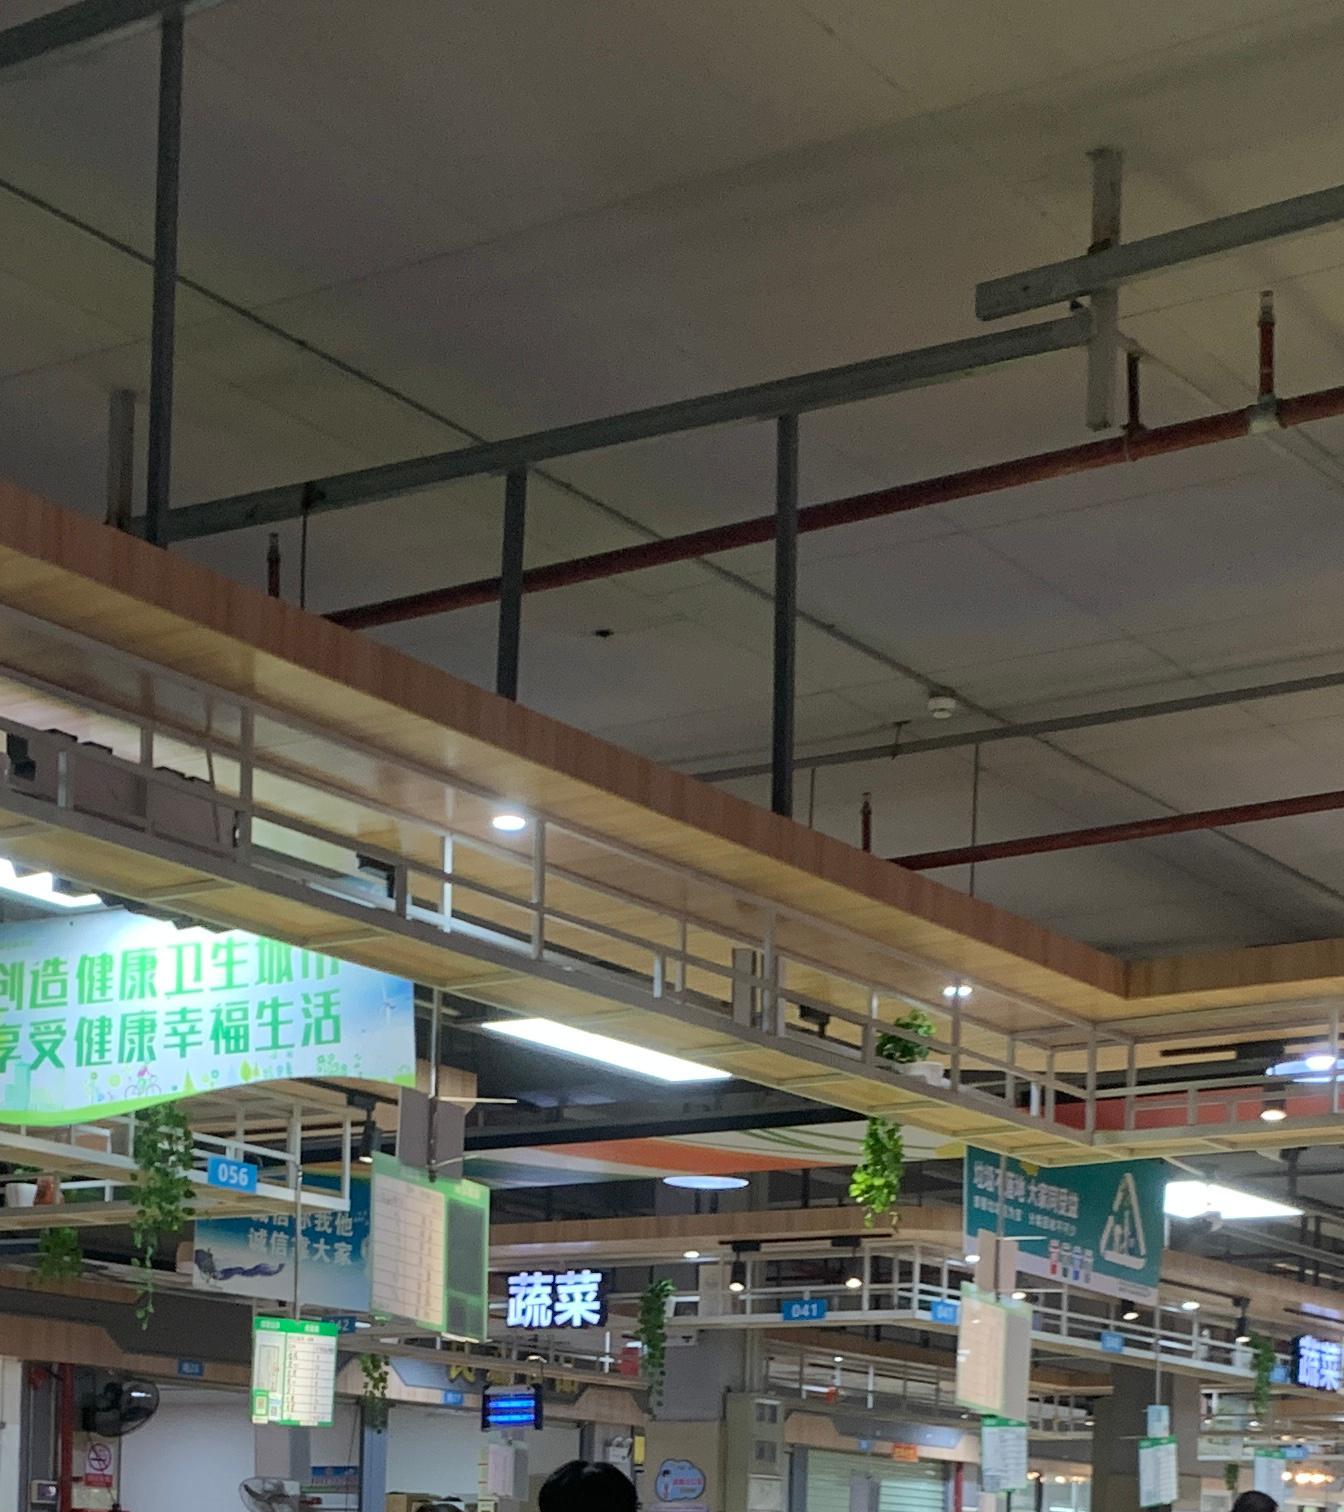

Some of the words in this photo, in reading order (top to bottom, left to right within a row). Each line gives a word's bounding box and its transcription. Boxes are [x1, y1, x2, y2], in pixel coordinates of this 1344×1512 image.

[217, 1162, 249, 1187] 056
[507, 1269, 603, 1328] 蔬菜
[790, 1303, 818, 1319] 041
[330, 1318, 350, 1332] 42
